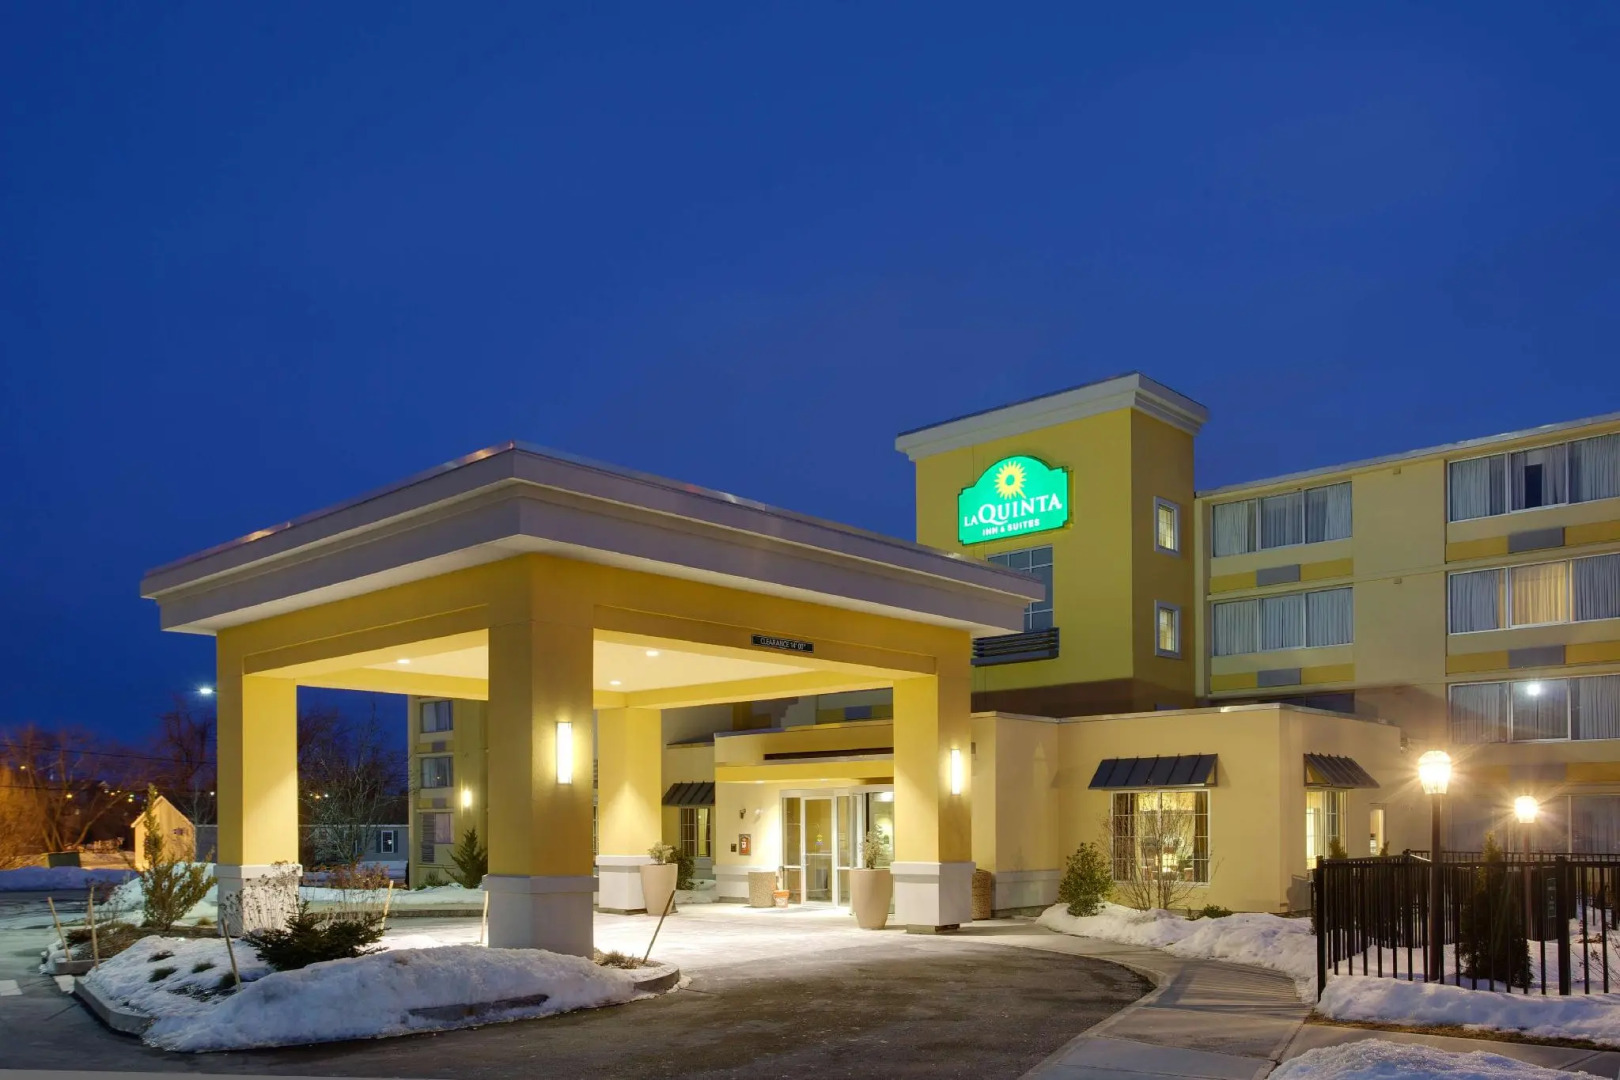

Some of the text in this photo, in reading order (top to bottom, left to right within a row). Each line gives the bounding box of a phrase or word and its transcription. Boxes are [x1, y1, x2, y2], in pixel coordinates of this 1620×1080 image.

[964, 493, 1063, 527] LA QUINTA
[982, 526, 998, 536] INN
[1007, 518, 1040, 532] SUITES
[760, 637, 789, 648] CLEARANCE
